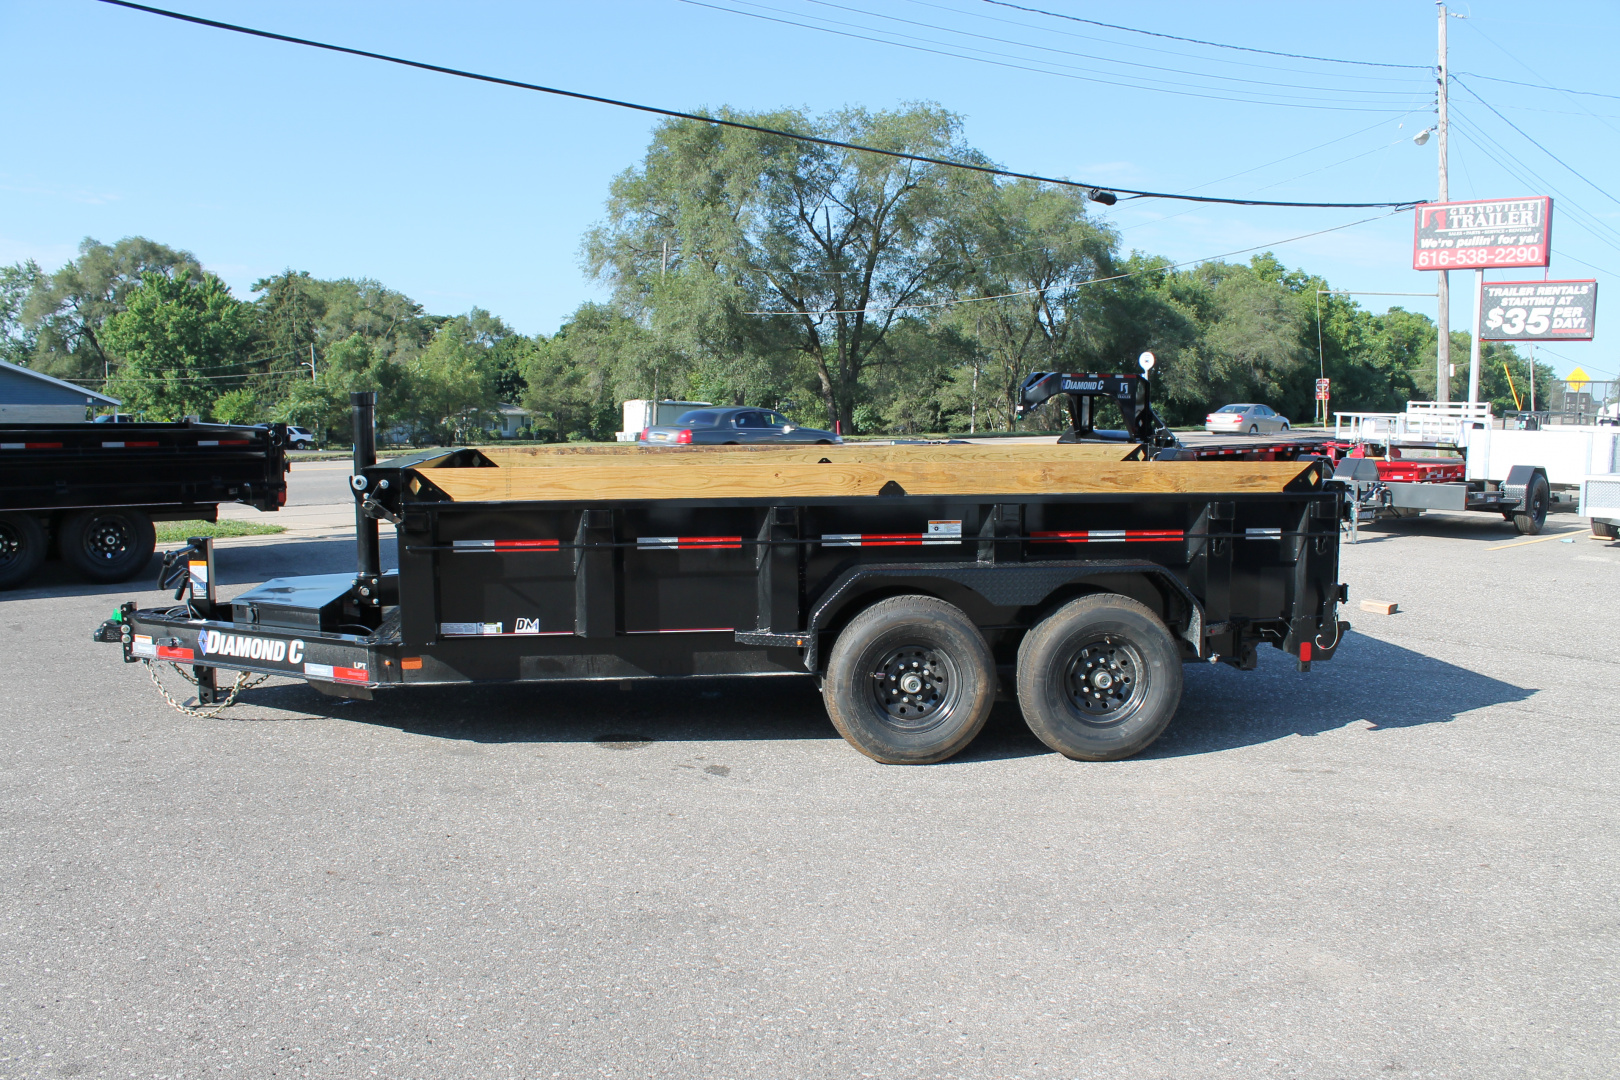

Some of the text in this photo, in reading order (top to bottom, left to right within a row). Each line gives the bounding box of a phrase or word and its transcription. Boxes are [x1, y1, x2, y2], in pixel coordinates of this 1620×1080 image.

[1450, 203, 1535, 215] GRANDVILLE
[1449, 211, 1535, 229] TRAILER
[1420, 233, 1539, 249] We're pullin' for ya!
[1418, 246, 1539, 266] 616-538-2290
[1488, 286, 1589, 297] TRAILER RENTALS
[1500, 296, 1574, 306] STARTING AT
[1552, 307, 1583, 318] PER
[1485, 306, 1553, 335] $35
[1551, 317, 1587, 329] DAY!
[1064, 379, 1104, 390] DIAMOND C
[516, 618, 539, 631] DM
[206, 630, 305, 664] DIAMOND C
[353, 661, 367, 670] LPT
